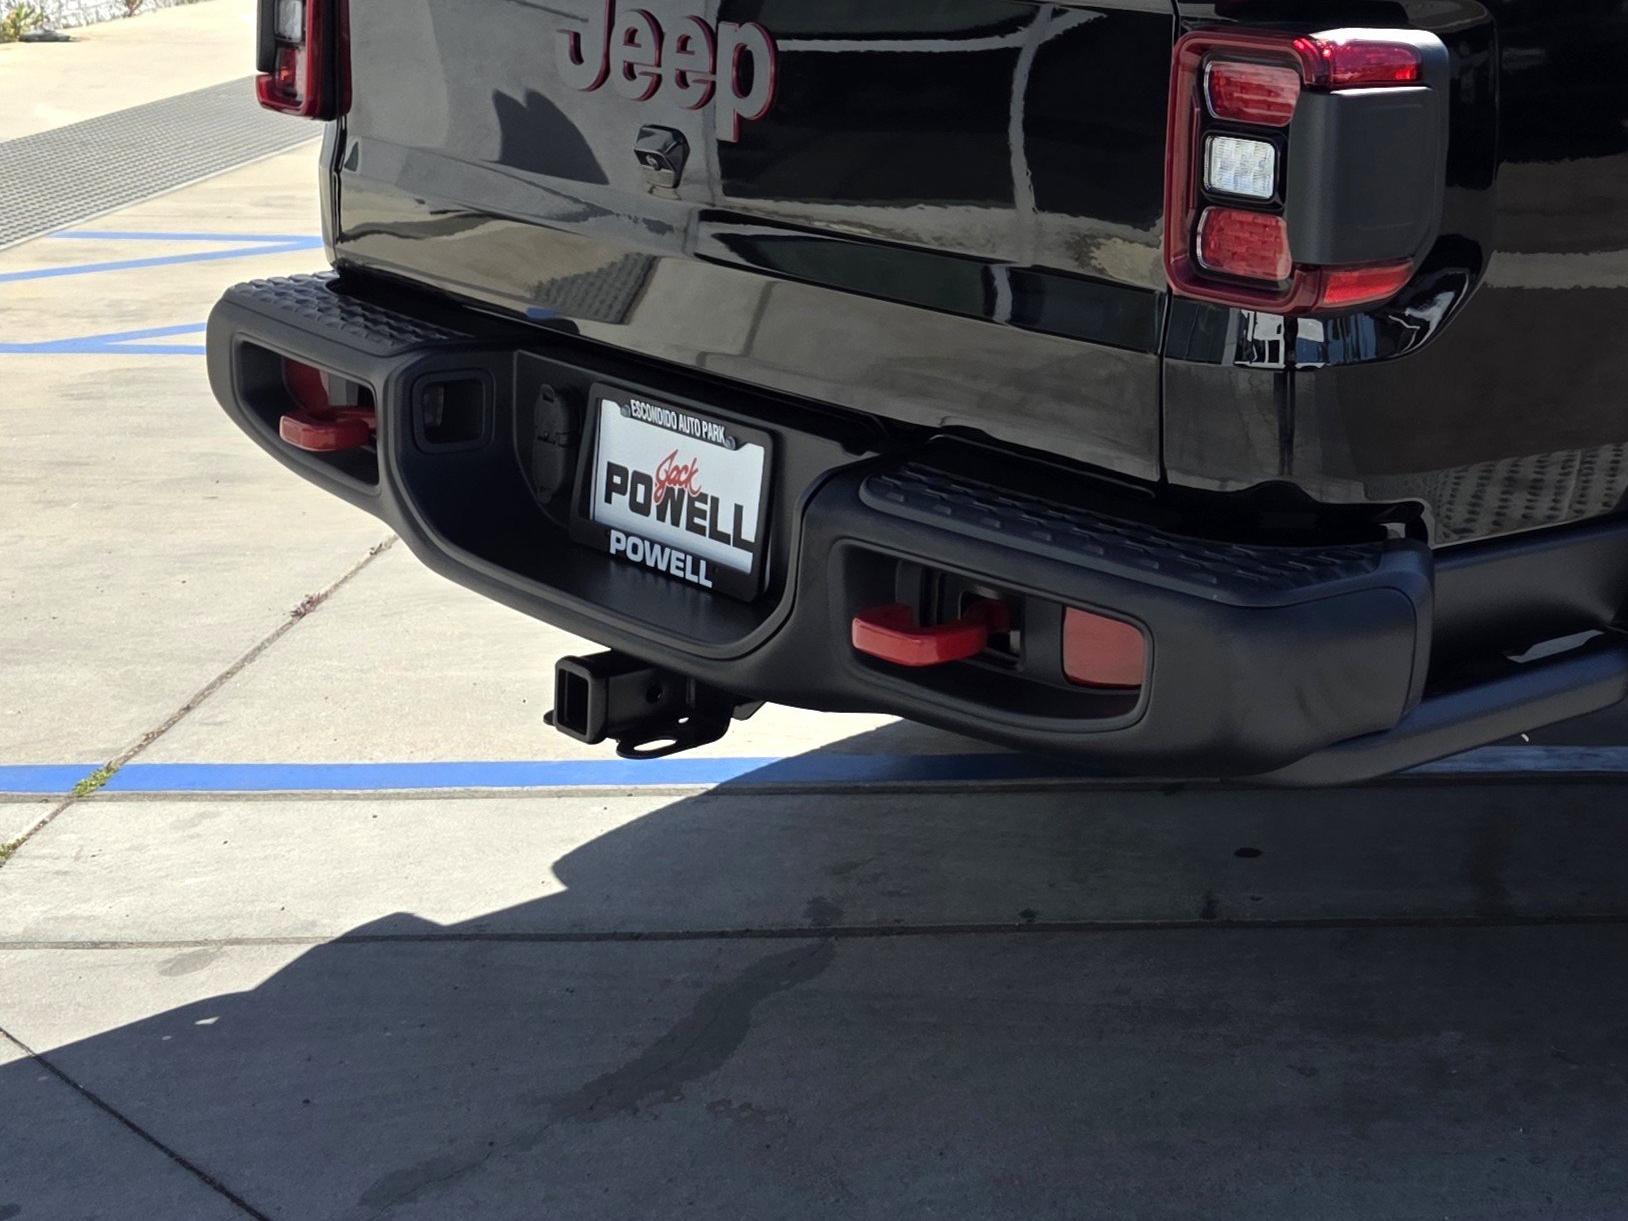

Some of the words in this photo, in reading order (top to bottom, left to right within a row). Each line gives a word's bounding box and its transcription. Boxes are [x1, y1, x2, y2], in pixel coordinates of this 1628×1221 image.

[630, 399, 677, 430] ESCONDIDO
[678, 413, 701, 438] AUTO
[702, 420, 726, 444] PARK
[654, 450, 701, 503] Jack
[604, 461, 756, 553] POWELL
[609, 529, 713, 588] POWELL
